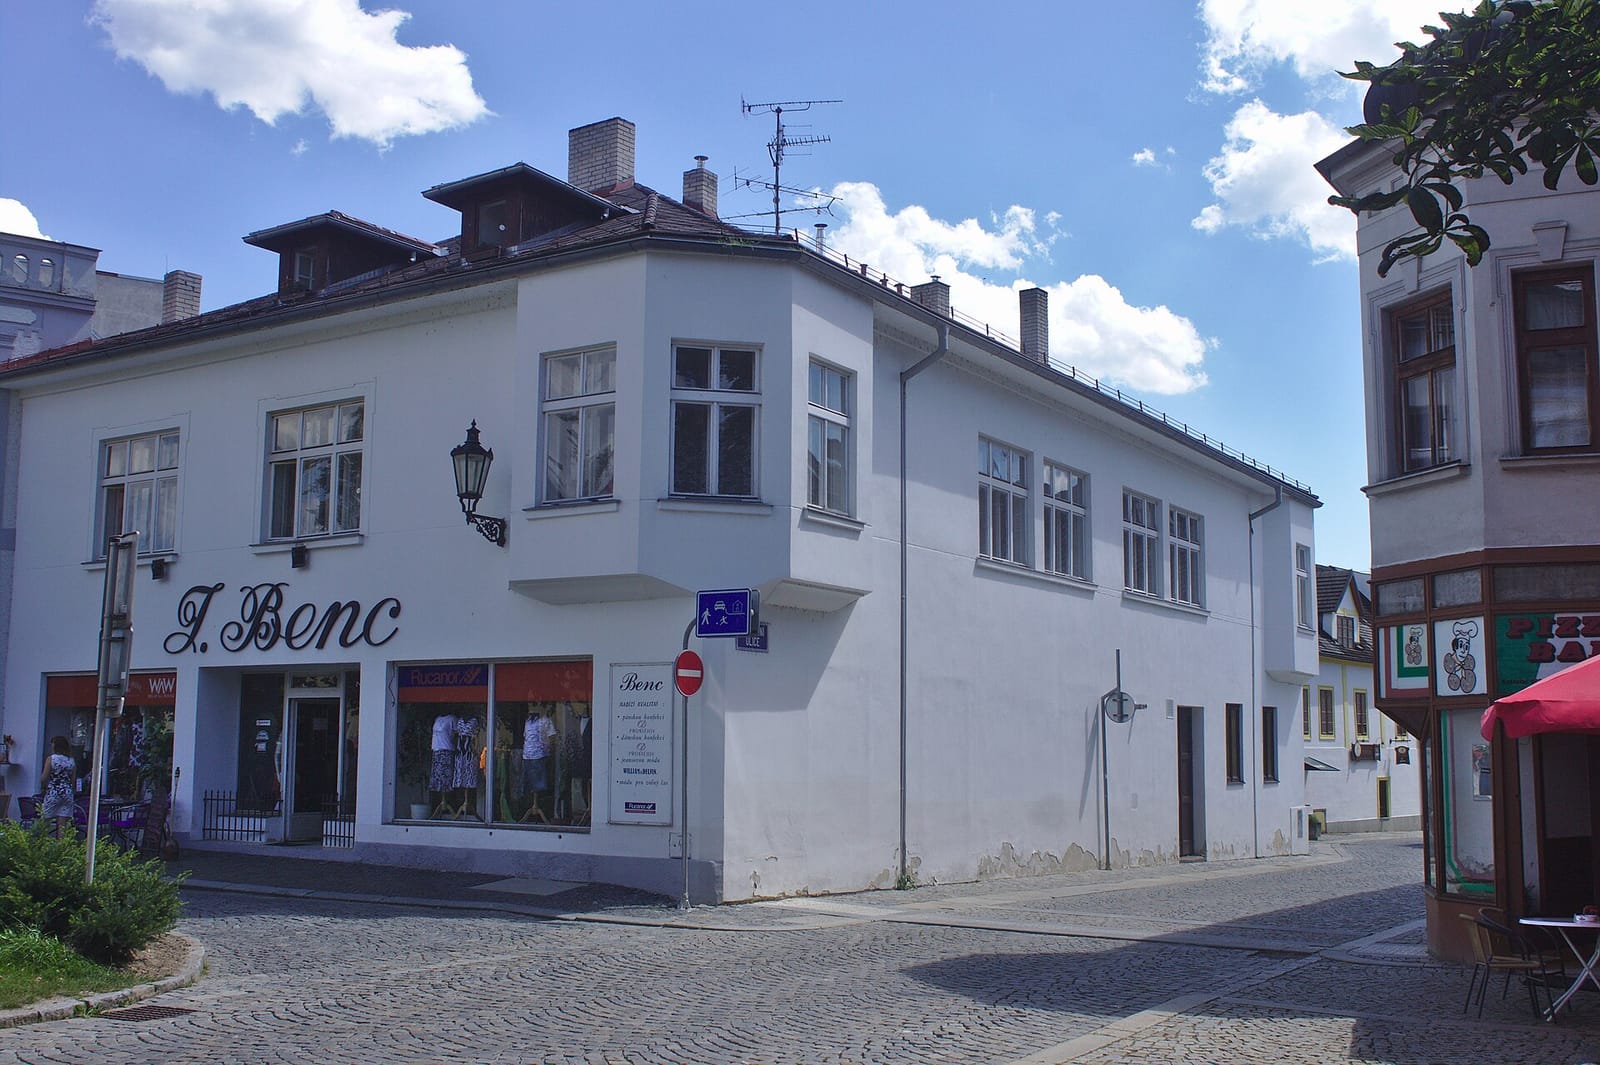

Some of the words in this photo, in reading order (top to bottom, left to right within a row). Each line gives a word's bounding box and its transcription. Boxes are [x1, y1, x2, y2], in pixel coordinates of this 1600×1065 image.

[220, 582, 402, 653] Benc
[410, 669, 460, 685] Rucanor
[620, 672, 664, 691] Benc
